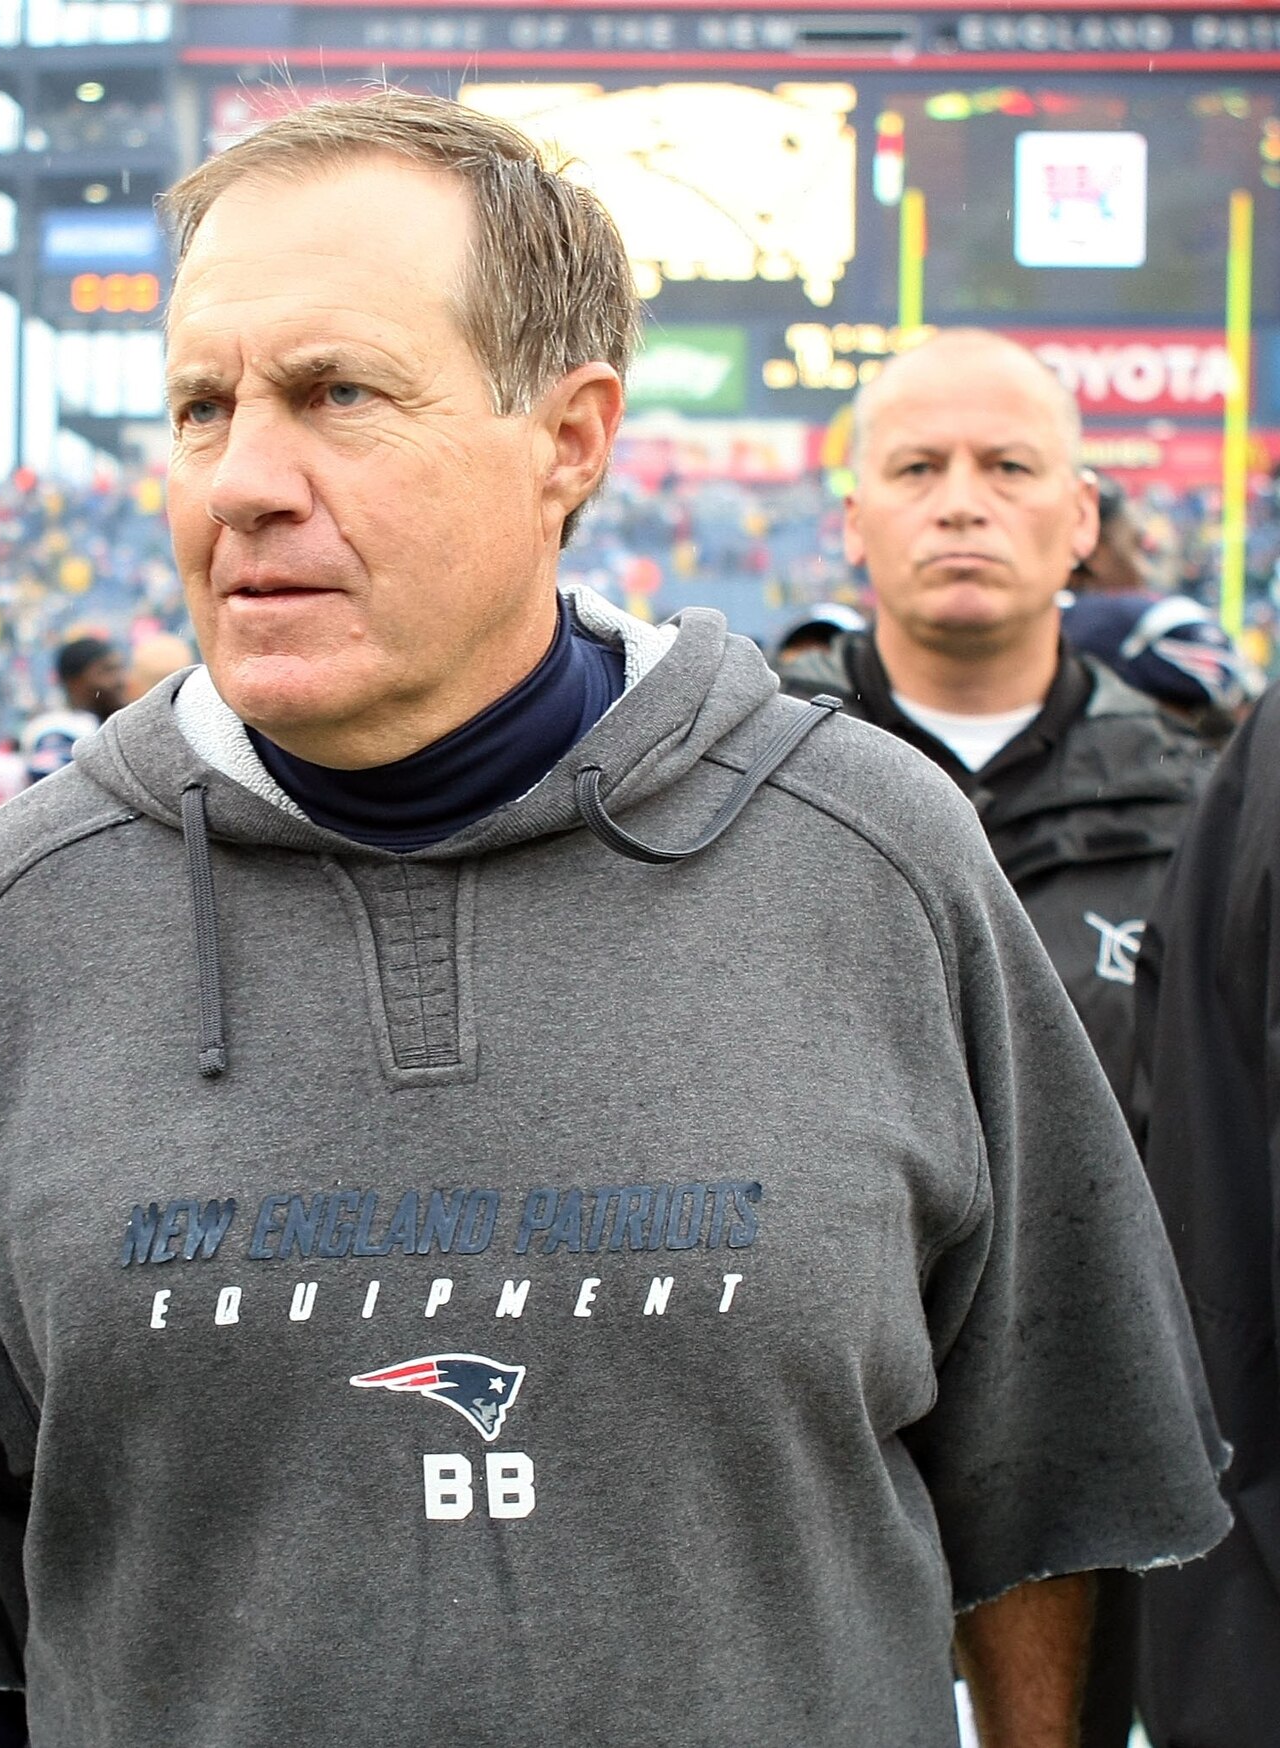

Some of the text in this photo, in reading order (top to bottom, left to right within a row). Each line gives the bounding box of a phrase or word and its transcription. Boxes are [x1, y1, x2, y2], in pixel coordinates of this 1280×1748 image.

[509, 14, 568, 50] OF
[957, 13, 1173, 52] ENGLAND
[122, 1180, 763, 1268] NEW ENGLAND PATRIOTS
[150, 1273, 743, 1330] EQUIPMENT
[422, 1451, 537, 1521] BB
